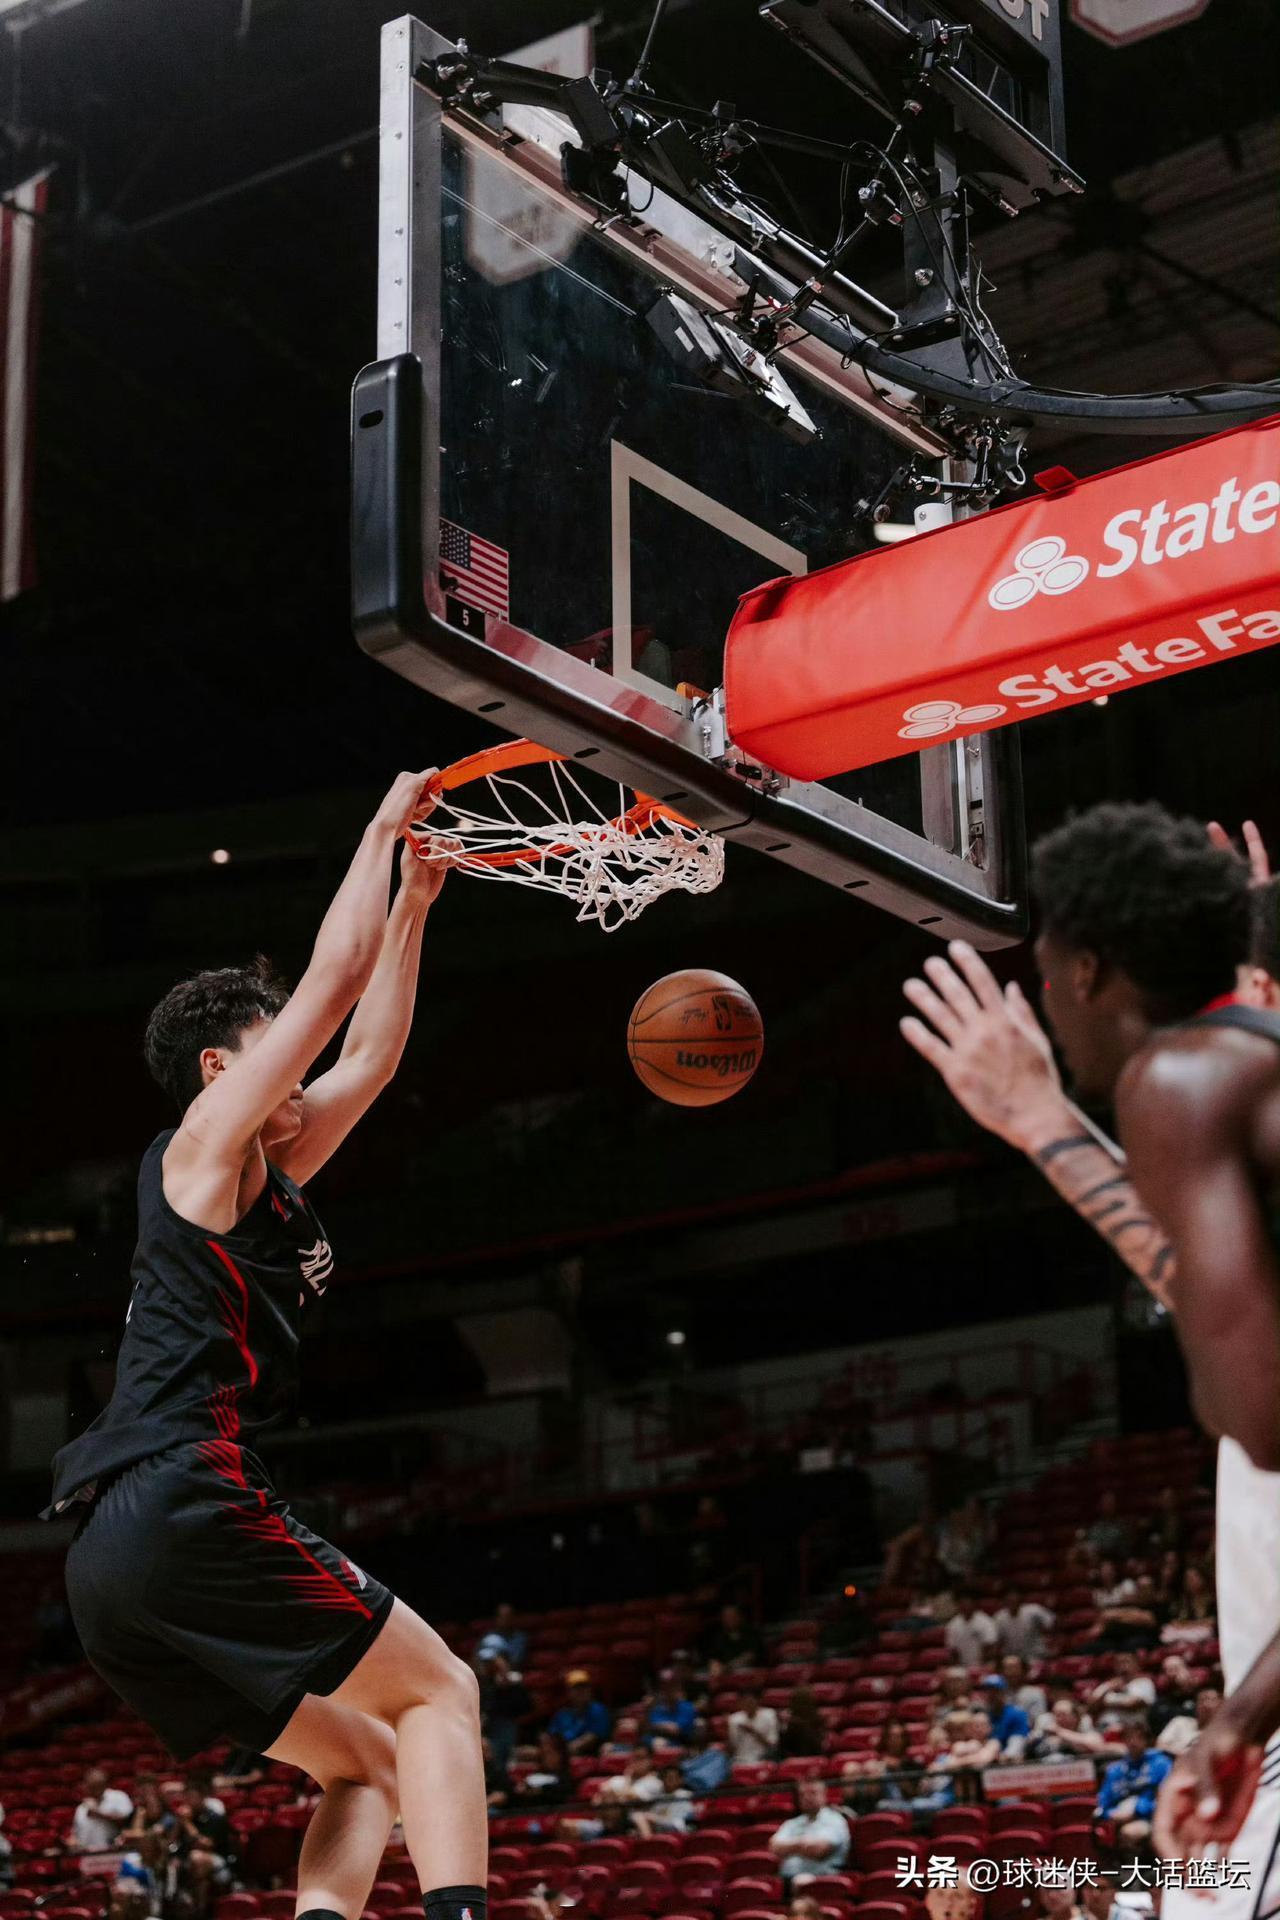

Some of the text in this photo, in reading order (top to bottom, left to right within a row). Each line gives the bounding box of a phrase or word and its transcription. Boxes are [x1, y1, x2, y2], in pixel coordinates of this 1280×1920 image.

[1096, 476, 1280, 578] State
[462, 609, 469, 626] 5
[997, 637, 1207, 708] State
[676, 1048, 757, 1076] Wilson
